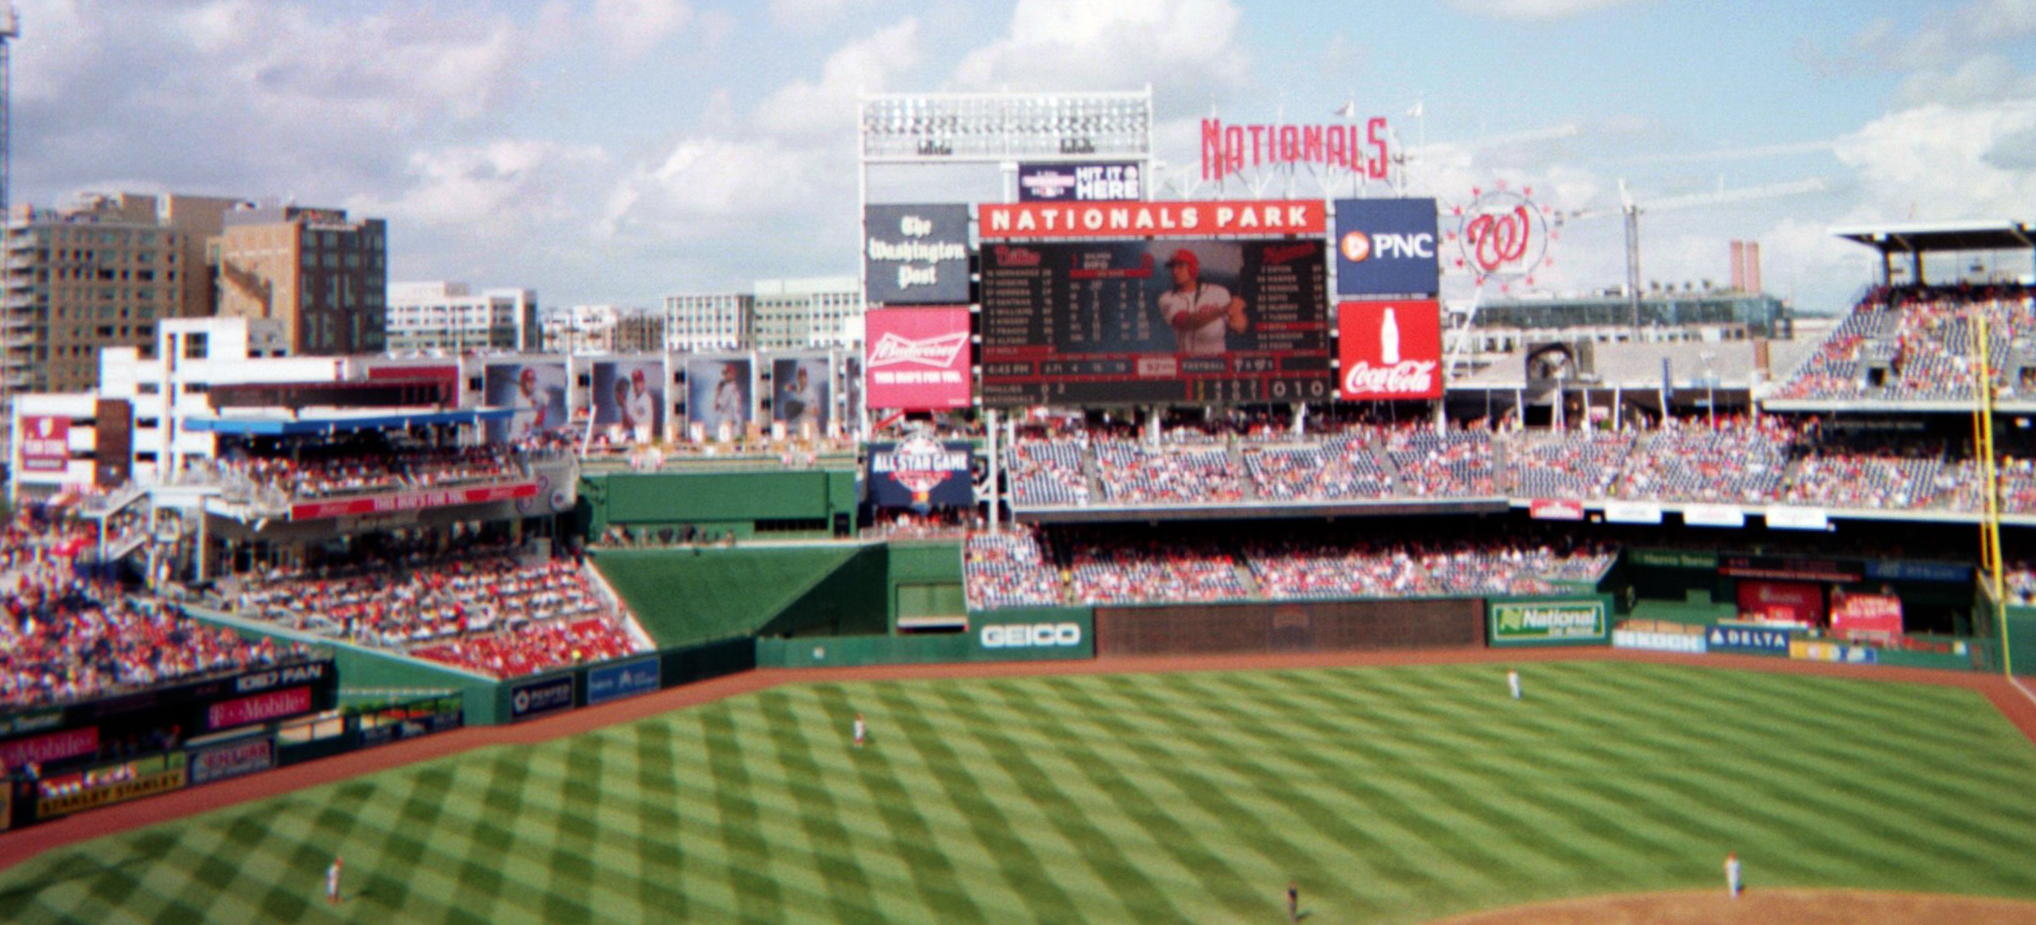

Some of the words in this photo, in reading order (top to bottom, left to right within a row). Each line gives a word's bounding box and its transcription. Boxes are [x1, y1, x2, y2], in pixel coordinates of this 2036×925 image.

[1201, 116, 1387, 181] NATIONALS
[1076, 166, 1103, 181] HIT
[1107, 166, 1123, 180] IT
[1077, 180, 1139, 199] HERE
[901, 215, 932, 238] The
[991, 206, 1198, 231] NATIONALS
[1217, 205, 1307, 228] PARK
[869, 237, 966, 264] Washington
[1372, 233, 1434, 259] PNC
[898, 265, 937, 290] Post
[875, 341, 958, 359] Budweiser
[1345, 360, 1436, 394] Coca-Cola
[933, 451, 968, 471] GAME
[1522, 607, 1597, 628] National
[980, 623, 1081, 648] GEICO
[1728, 631, 1786, 647] DELTA
